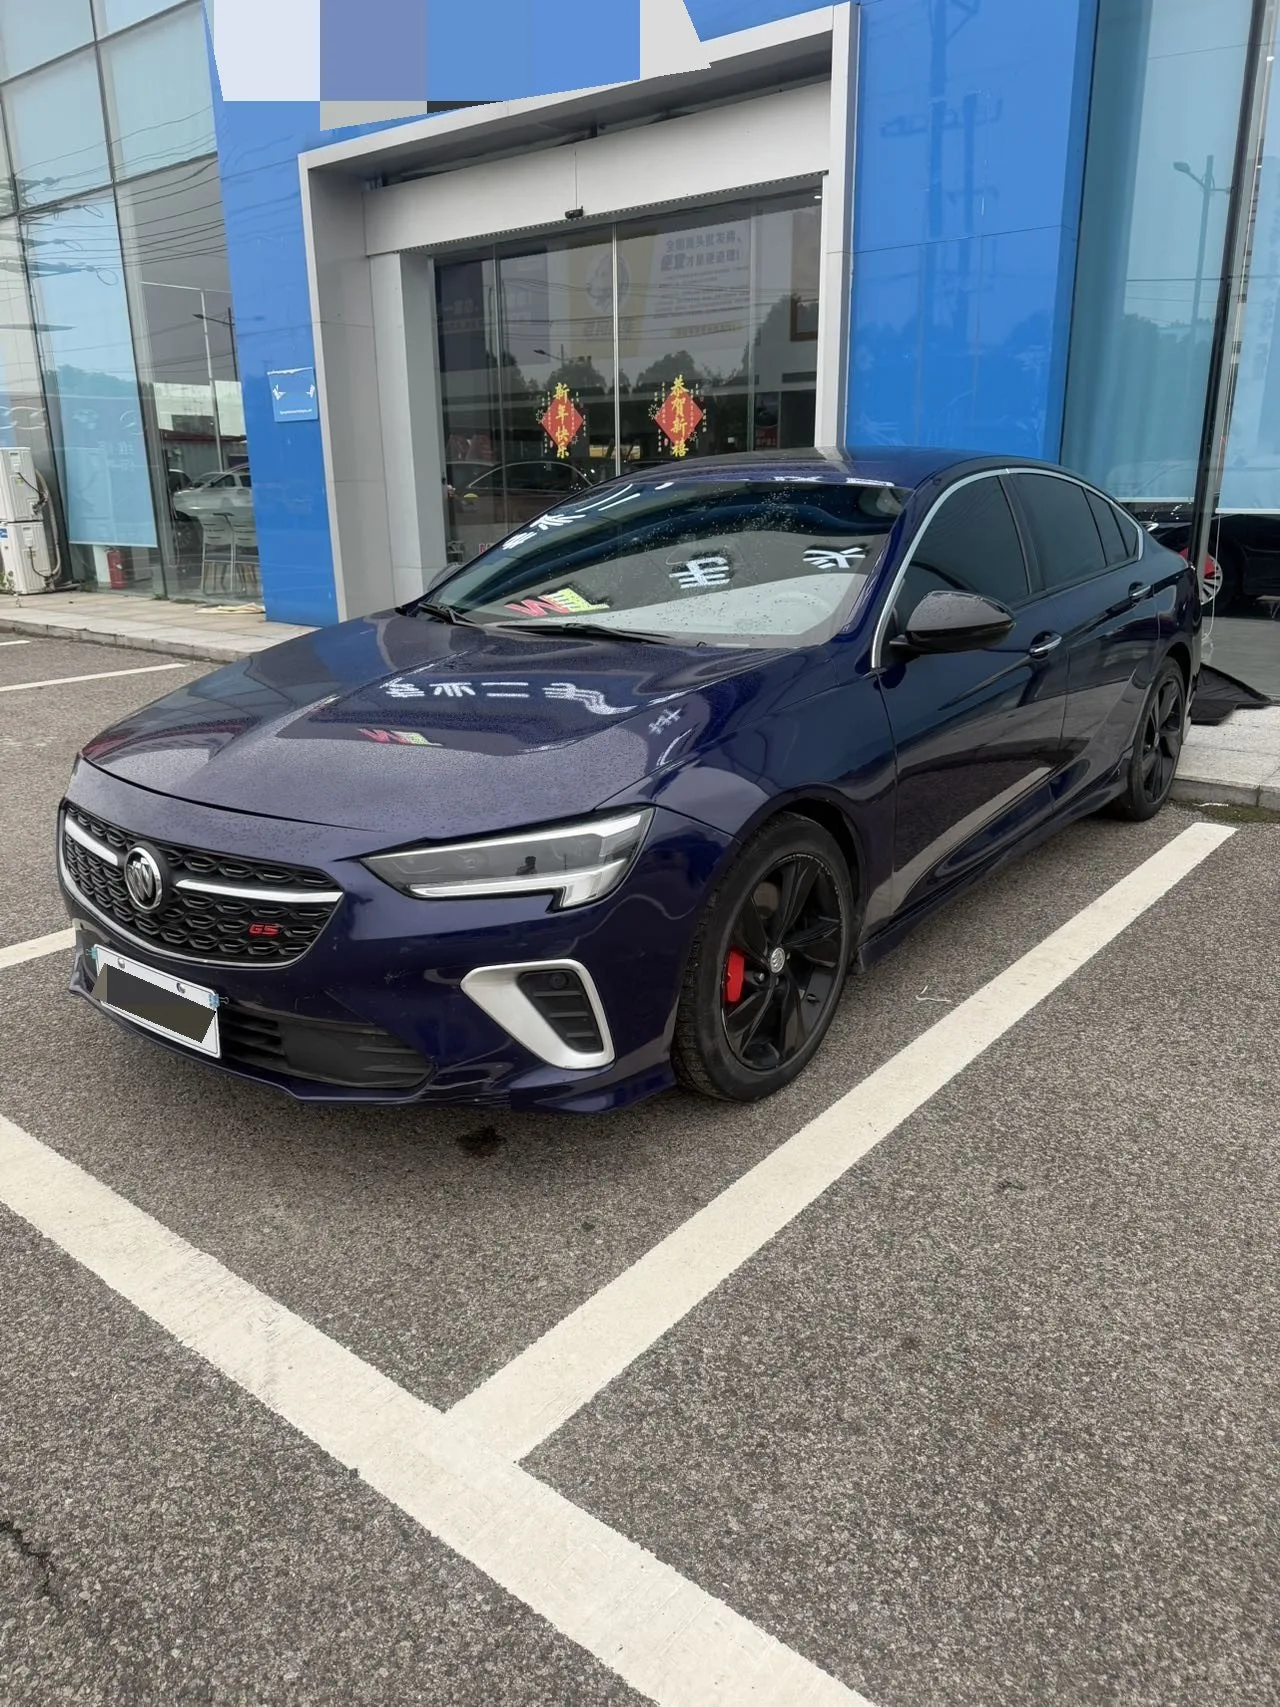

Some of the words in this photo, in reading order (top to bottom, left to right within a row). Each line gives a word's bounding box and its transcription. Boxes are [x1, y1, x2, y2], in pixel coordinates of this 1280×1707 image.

[553, 382, 570, 459] 新年快乐
[670, 374, 690, 457] 恭贺新禧
[250, 923, 281, 935] GS
